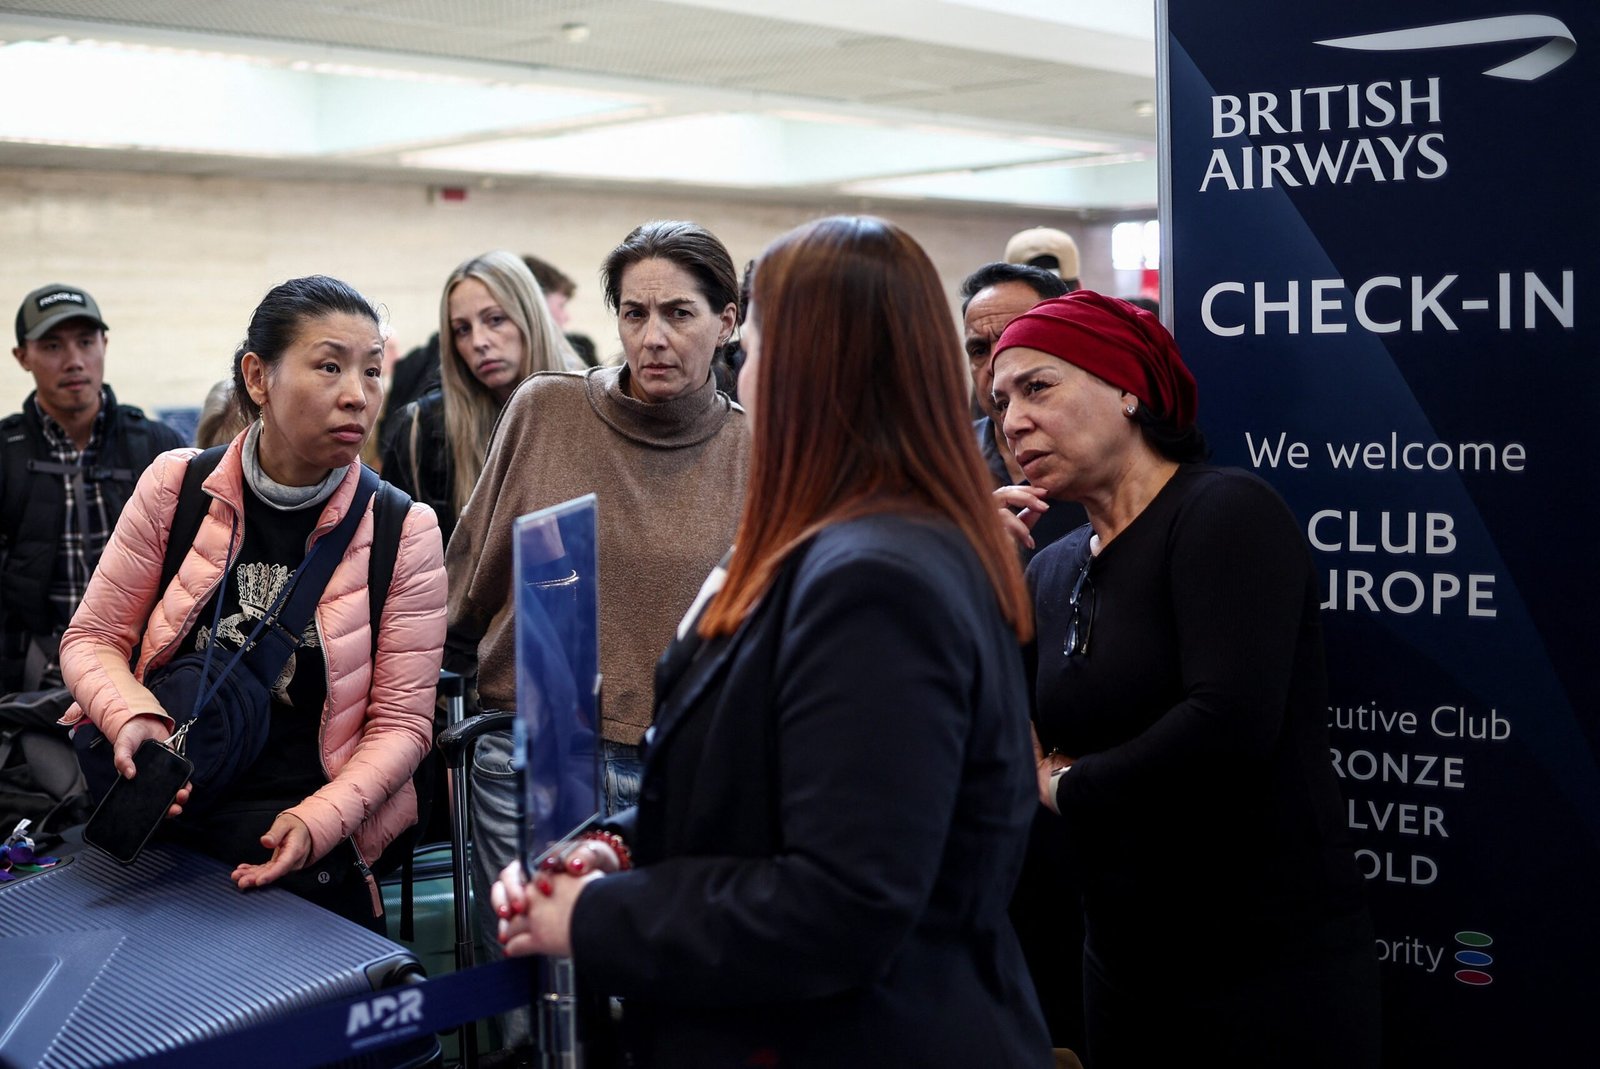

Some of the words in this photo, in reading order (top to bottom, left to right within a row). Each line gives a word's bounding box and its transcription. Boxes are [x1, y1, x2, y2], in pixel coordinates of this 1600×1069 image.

[1211, 77, 1441, 138] BRITISH
[1199, 133, 1448, 192] AIRWAYS
[1201, 270, 1574, 336] CHECK-IN
[1245, 432, 1310, 468] We
[1326, 431, 1526, 471] welcome
[1307, 509, 1457, 554] CLUB
[1431, 705, 1511, 740] Club
[1349, 799, 1449, 837] LVER
[1354, 849, 1438, 885] OLD
[346, 988, 424, 1036] ADR
